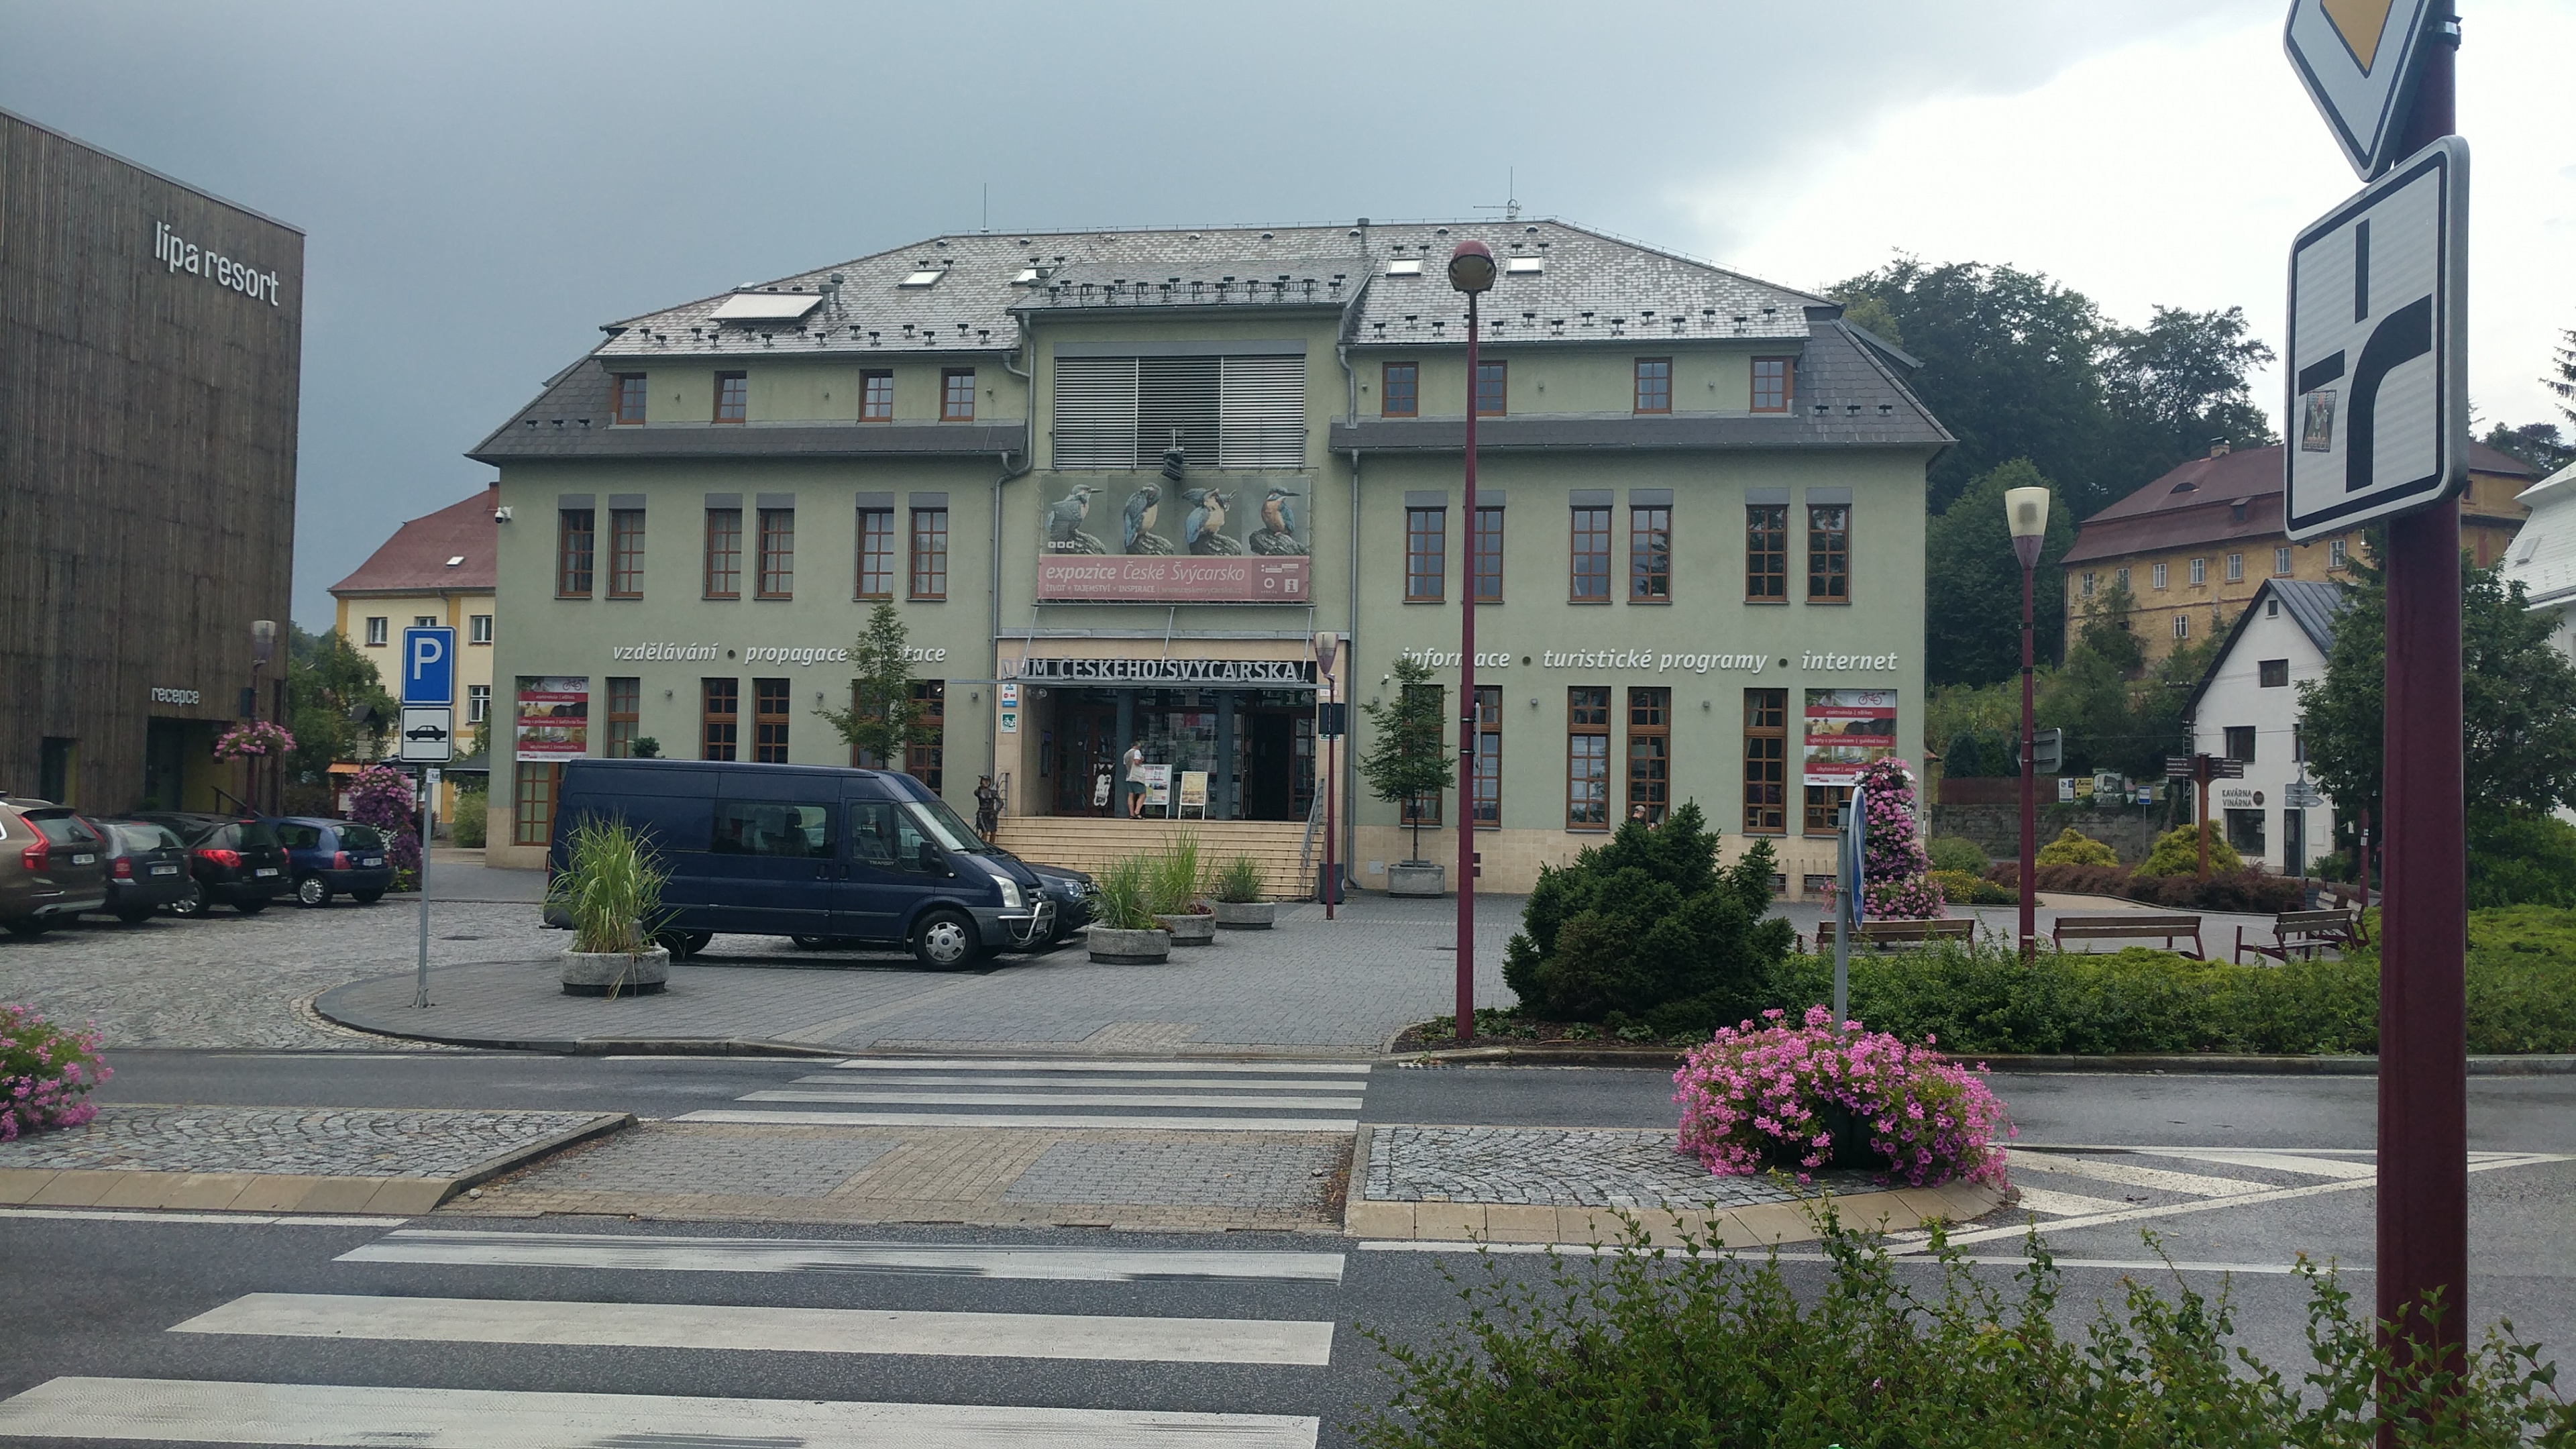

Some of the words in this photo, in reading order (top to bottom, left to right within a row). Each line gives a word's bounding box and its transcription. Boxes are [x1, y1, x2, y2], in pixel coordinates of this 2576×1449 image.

[156, 221, 199, 274] lípa
[205, 250, 279, 307] resort
[1046, 563, 1117, 583] expozice
[1123, 560, 1165, 580] České
[1171, 561, 1245, 584] Švýcarsko
[1046, 583, 1065, 591] ŽIVOT
[1073, 584, 1110, 592] TAJEMSTVÍ
[414, 637, 442, 680] P
[614, 642, 719, 661] vzdělávání
[745, 647, 848, 666] propagace
[1544, 648, 1652, 668] turistické
[1658, 653, 1767, 674] programy
[1802, 650, 1898, 670] internet
[152, 688, 199, 707] recepce
[2222, 788, 2252, 798] KAVÁRNA
[2222, 798, 2252, 808] VINÁRNA
